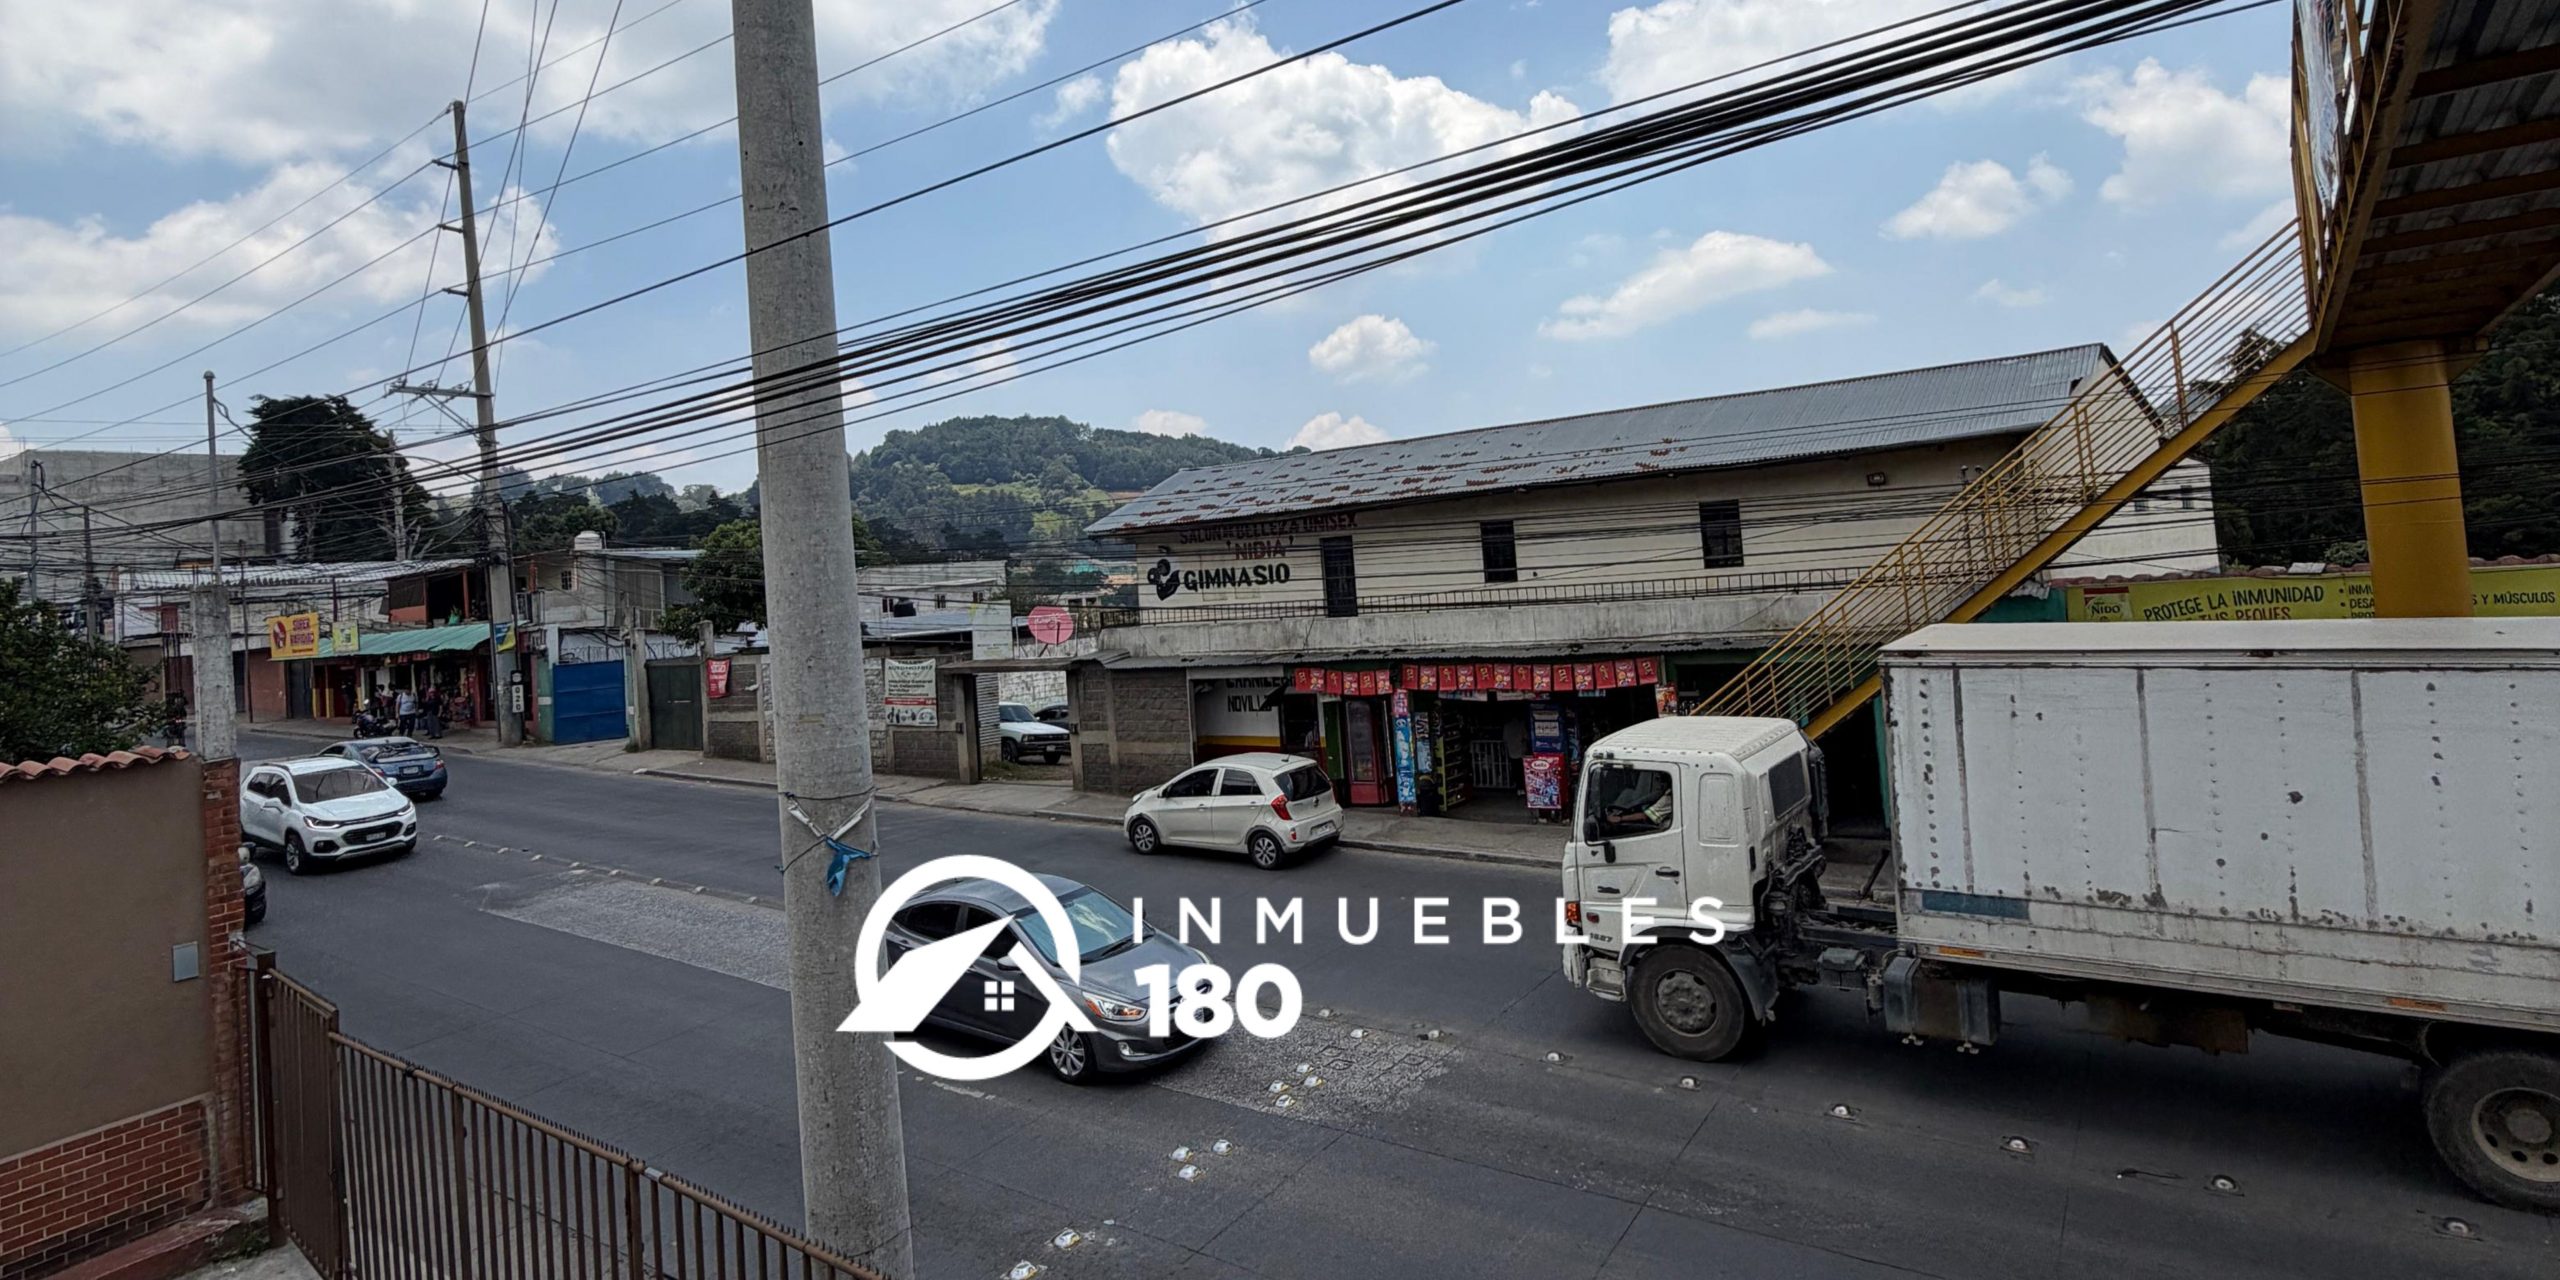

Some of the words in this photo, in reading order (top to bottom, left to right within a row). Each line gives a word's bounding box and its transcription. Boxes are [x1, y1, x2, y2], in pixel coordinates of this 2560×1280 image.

[1184, 563, 1290, 591] GIMNASIO
[2143, 597, 2204, 620] PROTEGE
[2207, 593, 2228, 610] LA
[2494, 590, 2555, 604] MÚSCULOS
